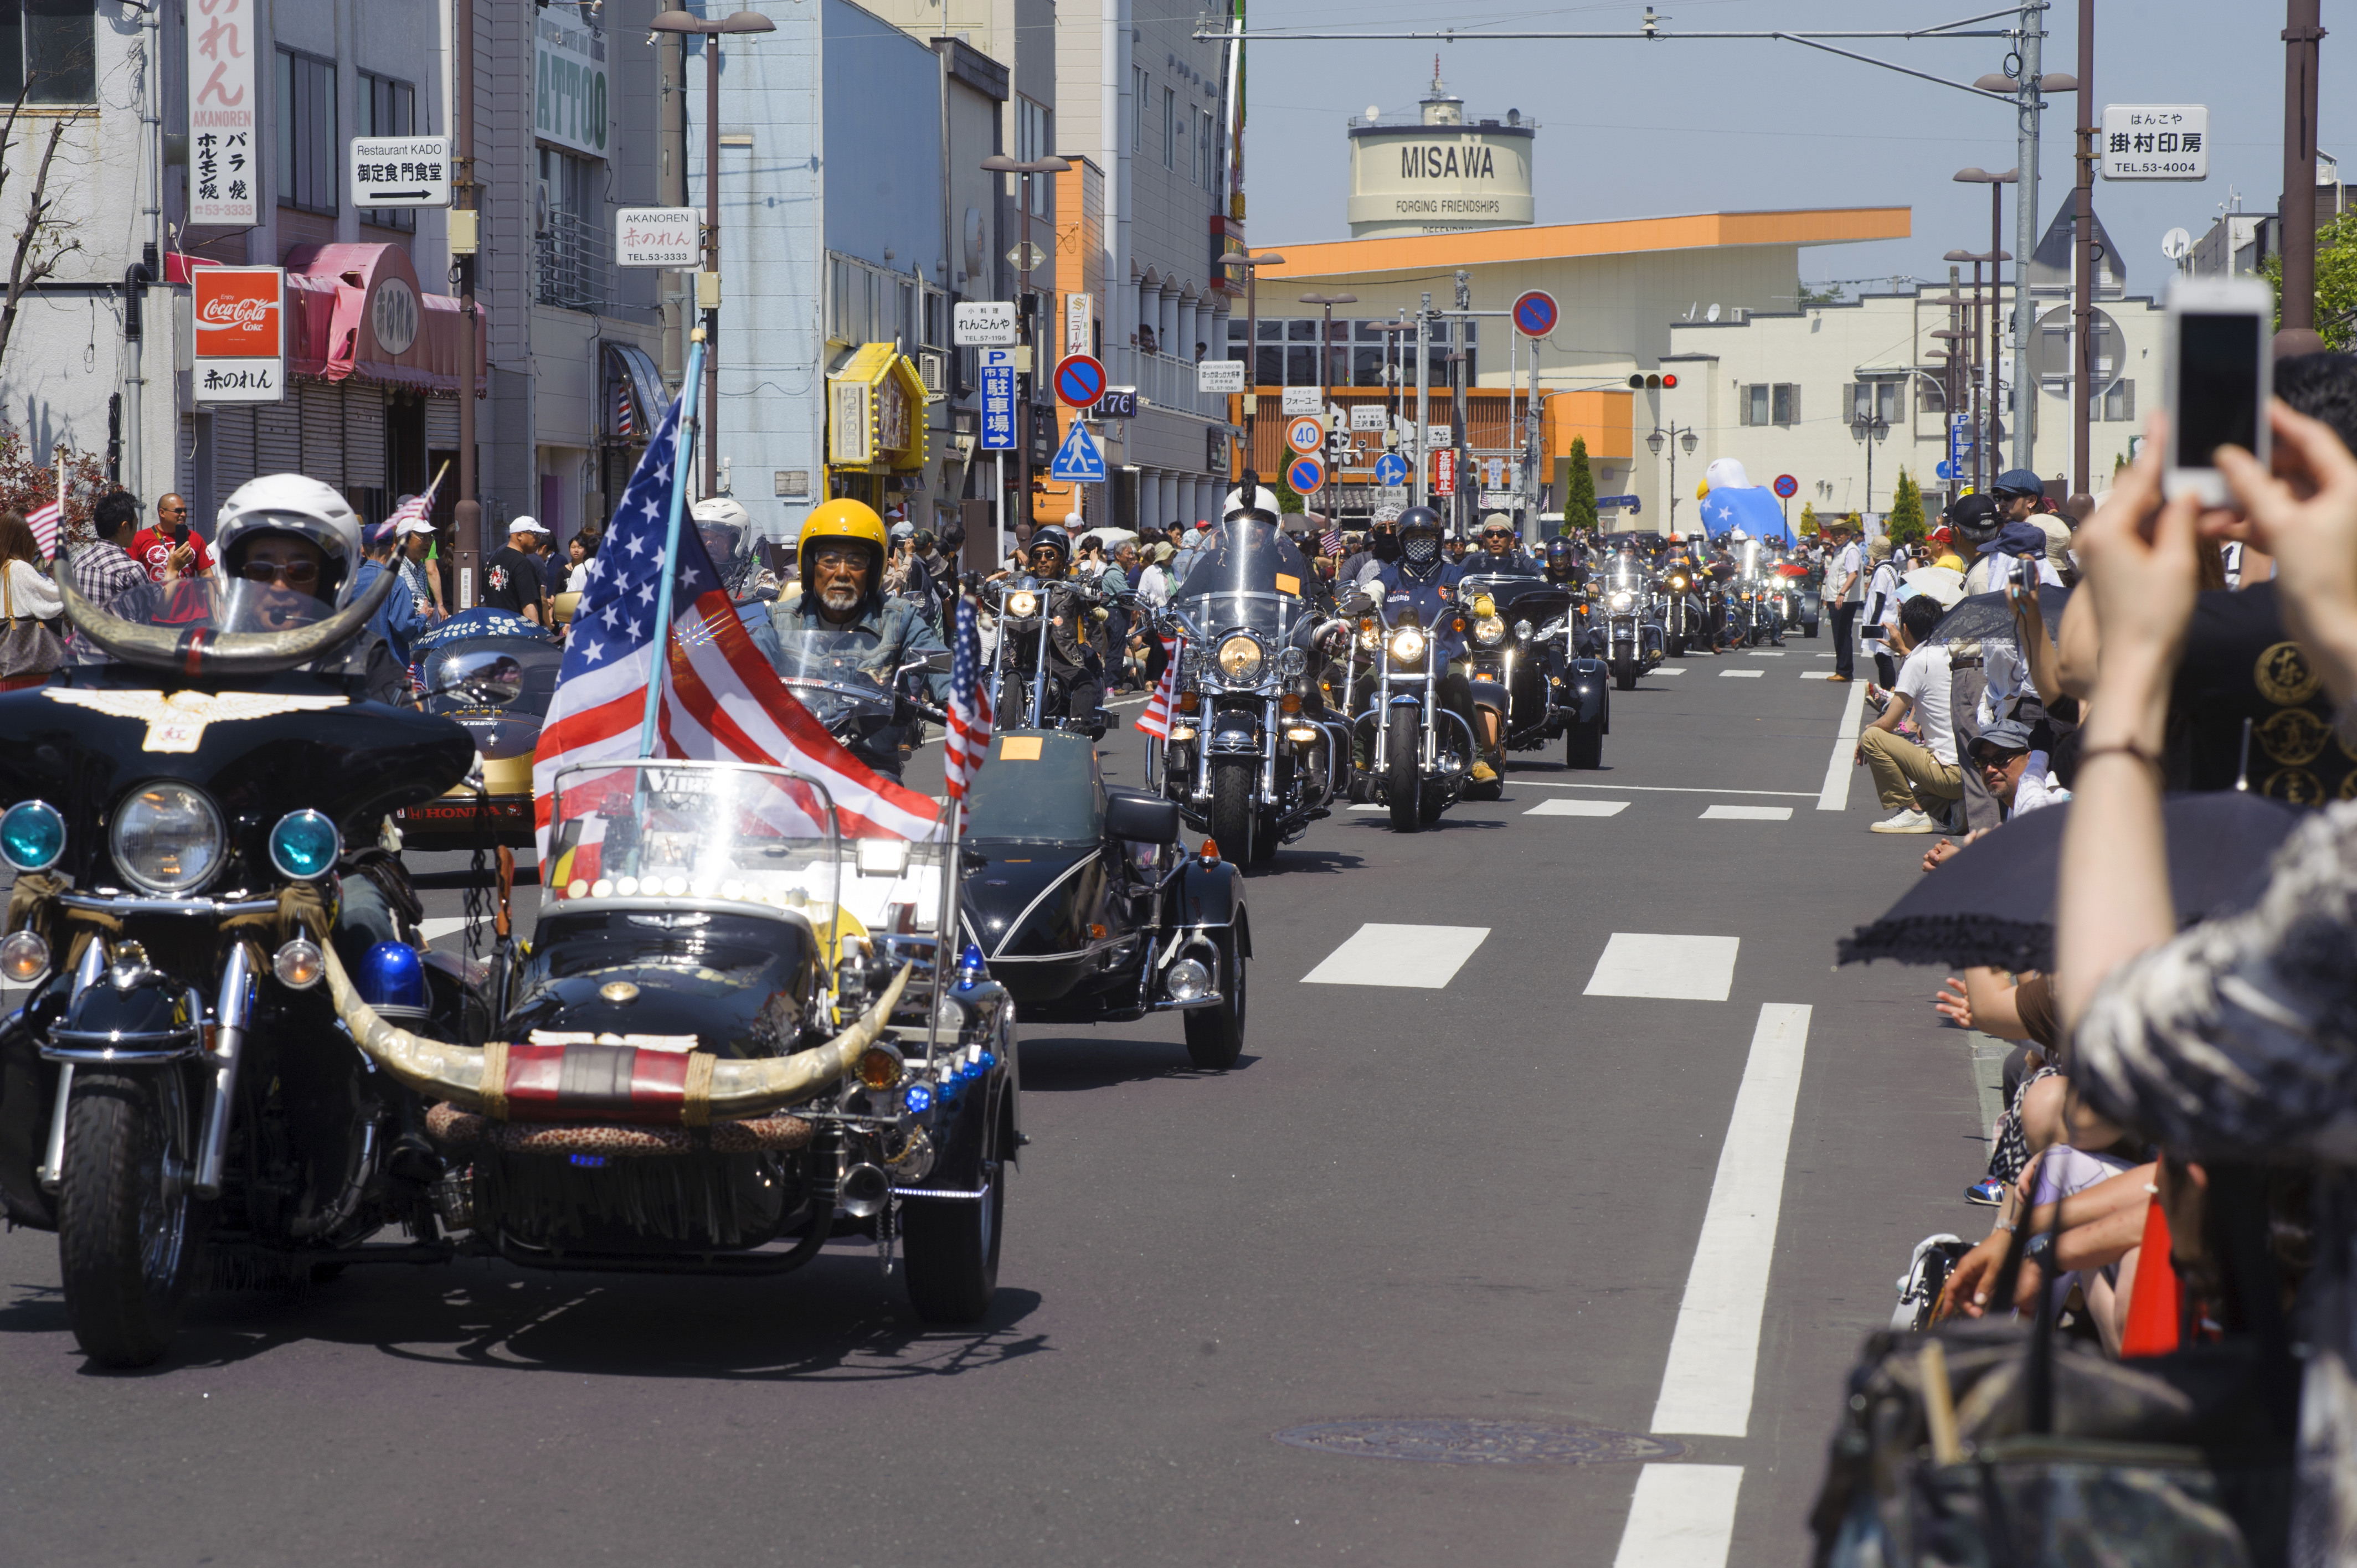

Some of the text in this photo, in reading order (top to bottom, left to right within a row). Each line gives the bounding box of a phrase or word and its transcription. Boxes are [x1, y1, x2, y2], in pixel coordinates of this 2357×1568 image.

[194, 110, 251, 127] AKANOREN
[2131, 114, 2183, 125] はんこや
[2109, 132, 2202, 153] 掛村印房
[357, 144, 442, 156] Restaurant KADO
[1402, 146, 1495, 178] MISAWA
[2115, 163, 2196, 172] TEL.53-4004
[1396, 200, 1500, 213] FORGING FRIENDSHIPS
[626, 214, 688, 223] AKANOREN
[623, 227, 691, 247] 赤のれん
[242, 321, 264, 331] Coke
[959, 318, 1010, 331] れんこんや
[989, 351, 1006, 365] P
[204, 369, 273, 390] 赤のれん
[985, 368, 1010, 378] 市営
[986, 378, 1010, 432] 駐車場
[1285, 397, 1319, 405] フォーユー
[1295, 427, 1316, 443] 40
[1439, 451, 1452, 491] 左折禁止
